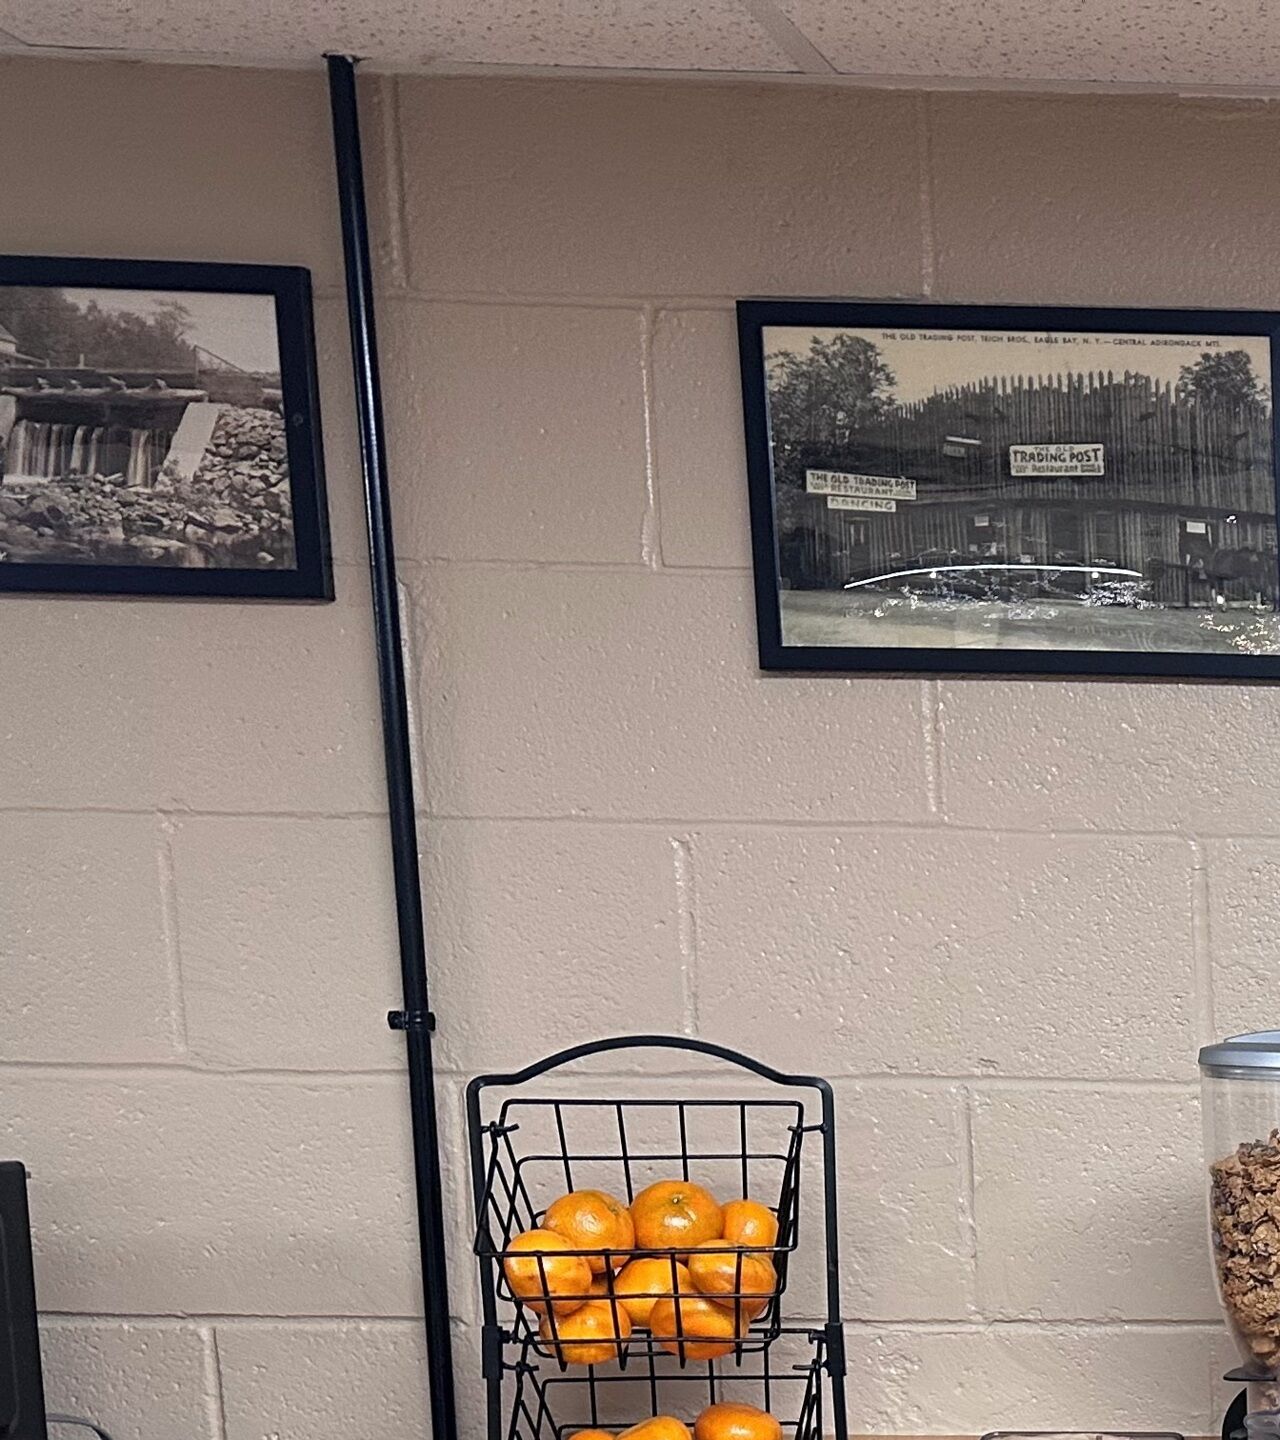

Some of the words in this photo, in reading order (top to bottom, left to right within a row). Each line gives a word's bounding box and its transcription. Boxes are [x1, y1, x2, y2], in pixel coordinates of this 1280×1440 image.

[900, 333, 916, 341] OLD
[919, 334, 953, 342] TRADING
[1034, 336, 1059, 345] EAGLE
[1150, 339, 1201, 348] ADIRONDACK
[1012, 450, 1067, 463] TRADING
[1069, 448, 1101, 463] POST
[810, 472, 828, 483] THE
[831, 474, 850, 485] OLD
[853, 476, 893, 488] TRADING
[895, 480, 915, 490] POST
[831, 485, 894, 496] RESTAURANT
[831, 498, 893, 510] DANCING
